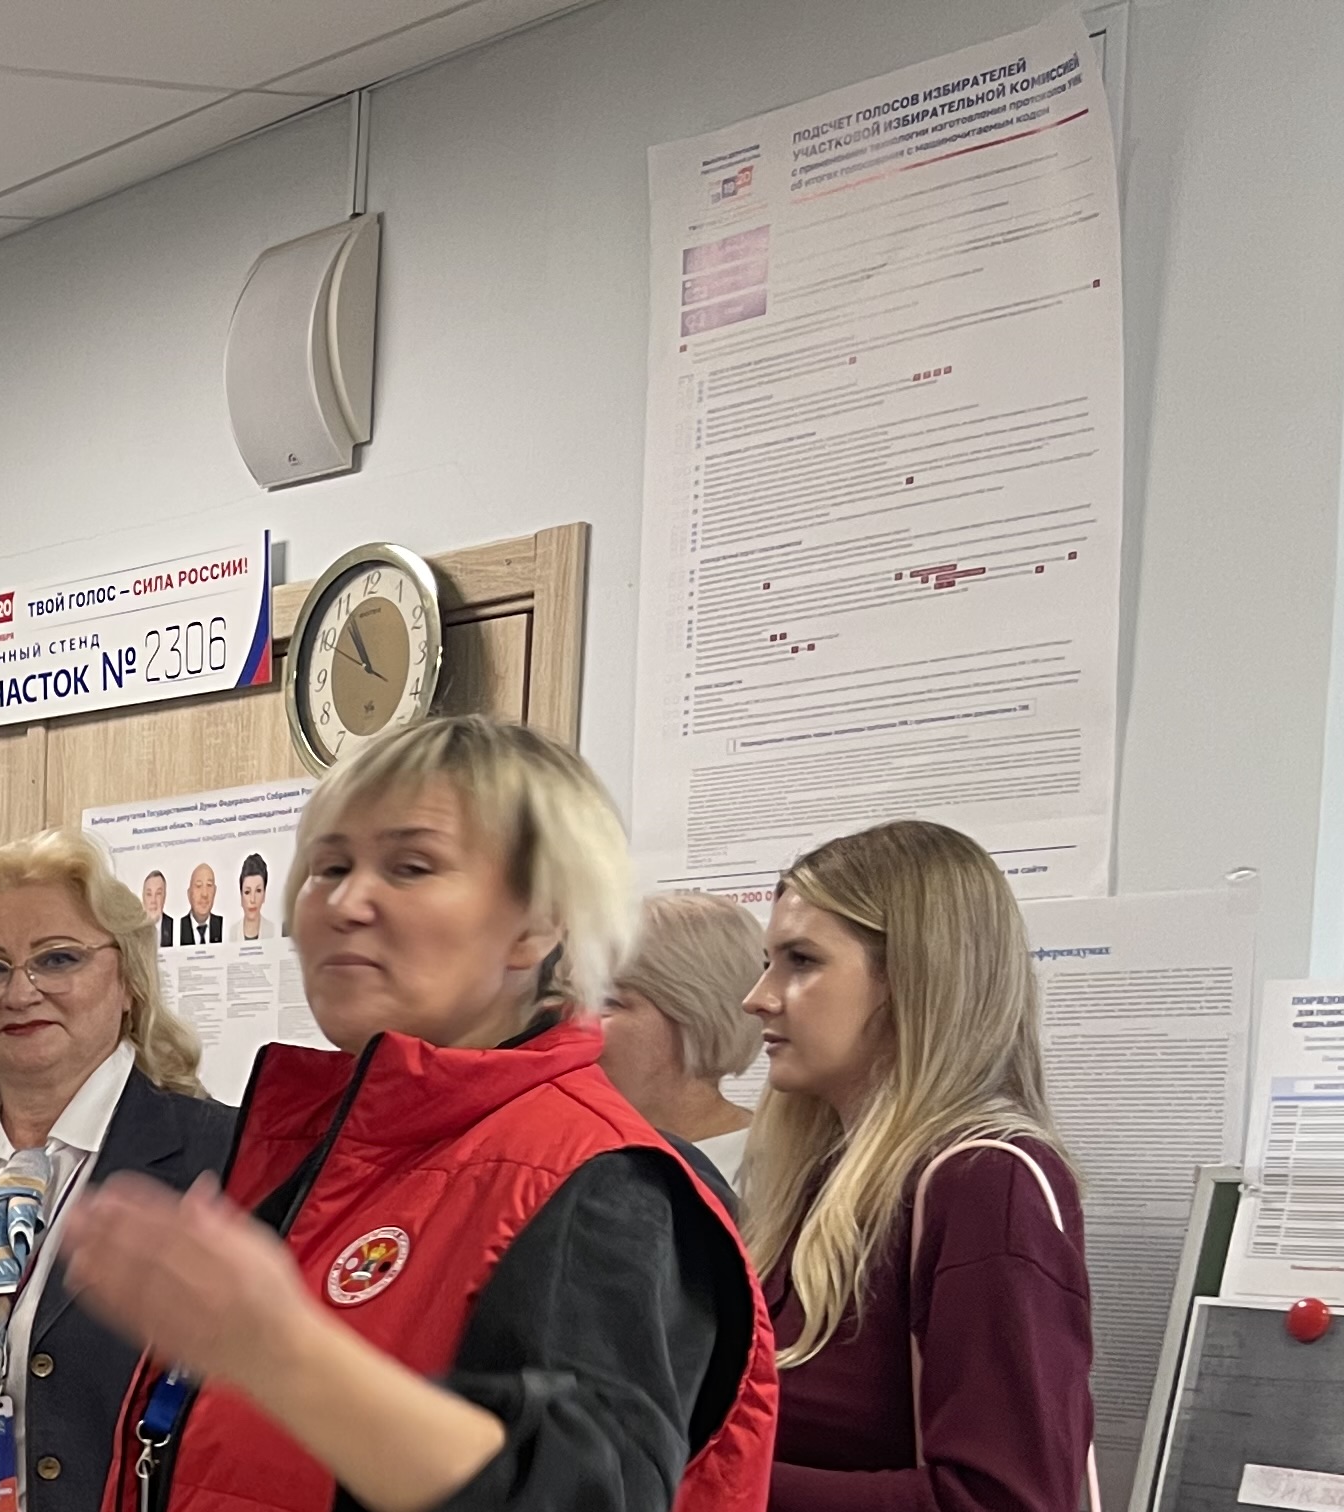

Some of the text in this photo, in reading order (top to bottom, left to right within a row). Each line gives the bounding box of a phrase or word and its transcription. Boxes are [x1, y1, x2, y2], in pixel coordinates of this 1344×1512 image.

[792, 57, 1027, 144] ПОДСЧЕТ ГОЛОСОВ ИЗБИРАТЕЛЕЙ
[792, 121, 881, 162] УЧАСТКОВОЙ
[883, 83, 1006, 132] ИЗБИРАТЕЛЬНОЙ
[28, 592, 65, 618] ТВОЙ
[69, 586, 116, 610] ГОЛОС
[133, 574, 174, 596] СИЛА
[178, 558, 249, 588] РОССИИ!
[362, 570, 381, 597] 12
[335, 592, 351, 620] 11
[411, 605, 425, 630] 2
[49, 634, 100, 655] СТЕНД
[318, 627, 337, 653] 10
[415, 640, 427, 665] 3
[102, 647, 137, 691] №
[145, 616, 227, 682] 2306
[314, 668, 327, 692] 9
[409, 677, 421, 700] 4
[320, 701, 331, 725] 8
[334, 731, 346, 756] 7
[741, 891, 763, 903] 200
